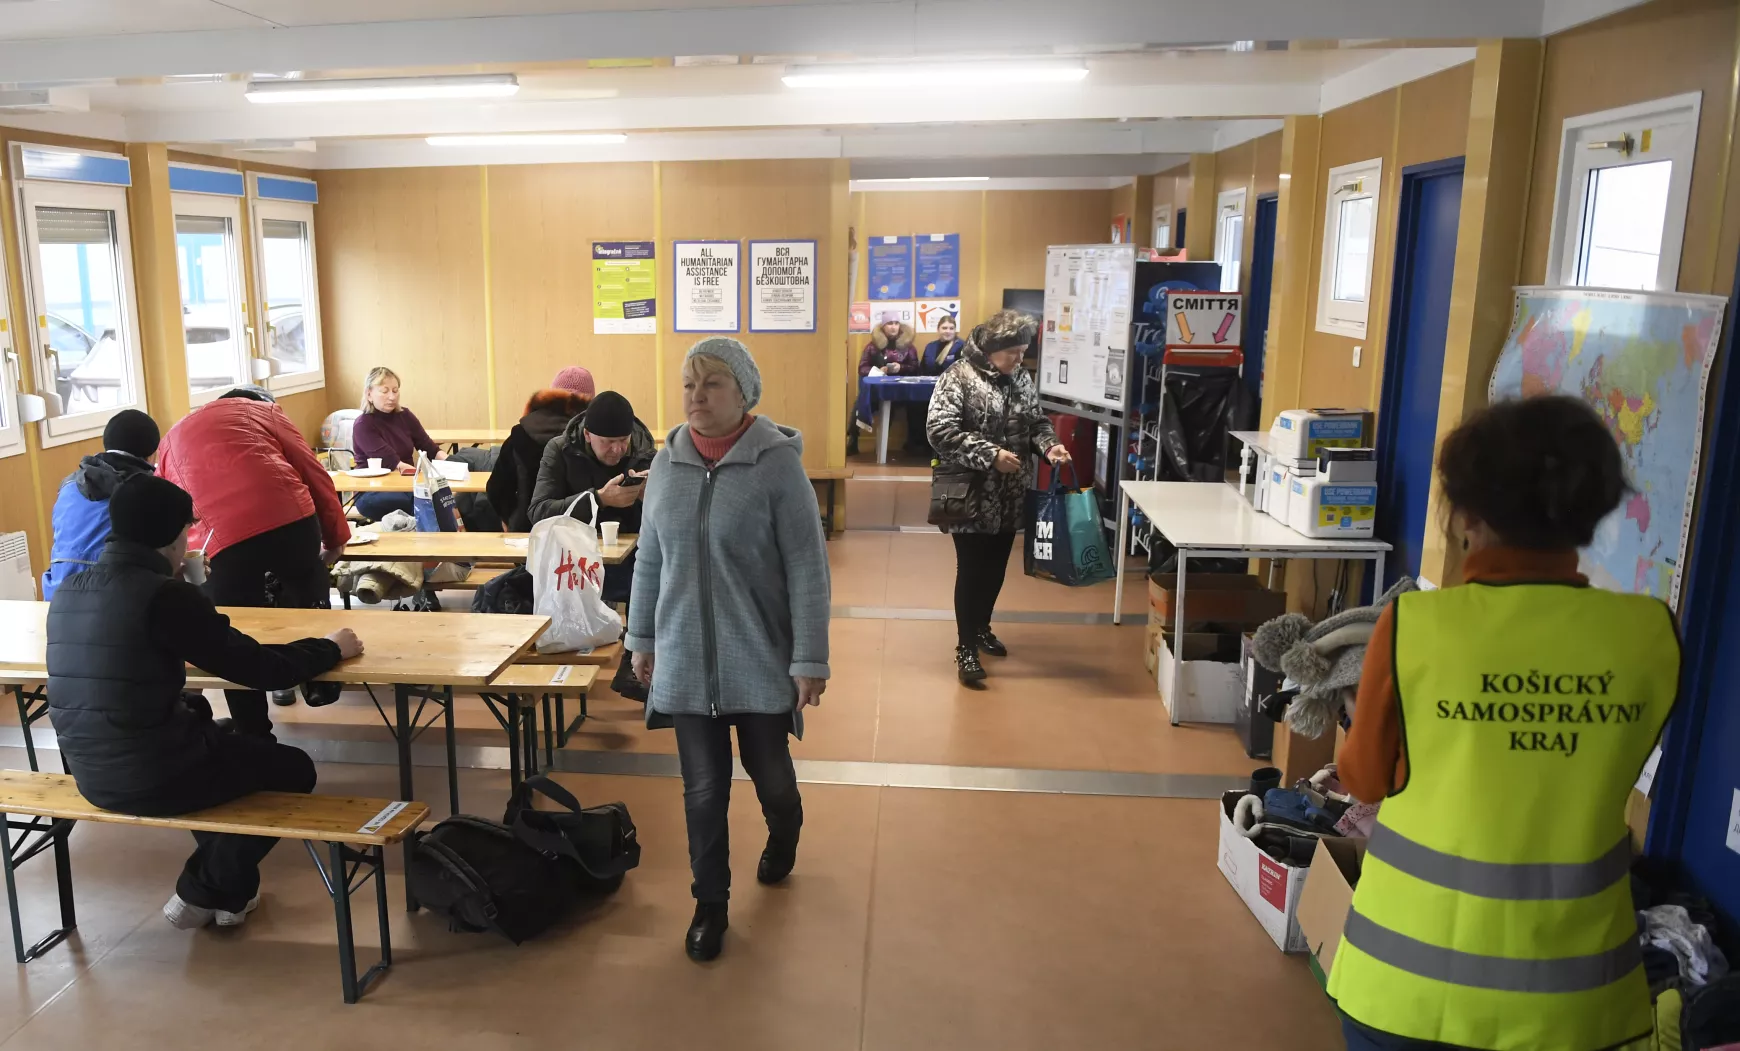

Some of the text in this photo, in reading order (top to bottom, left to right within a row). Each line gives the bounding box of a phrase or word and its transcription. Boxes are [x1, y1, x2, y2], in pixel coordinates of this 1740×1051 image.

[700, 248, 714, 257] ALL
[775, 247, 790, 257] ВСЯ
[680, 258, 733, 267] HUMANITARIAN
[757, 257, 809, 266] ГУМАНІТАРНА
[686, 267, 728, 276] ASSISTANCE
[762, 266, 802, 277] ДОПОМОГА
[694, 276, 720, 286] IS FREE
[755, 276, 810, 286] БЕЗКОШТОВНА
[1172, 297, 1239, 311] СМІТТЯ
[554, 548, 600, 591] H&M
[1480, 669, 1615, 696] KOŠICKÝ
[1508, 730, 1580, 757] KRAJ
